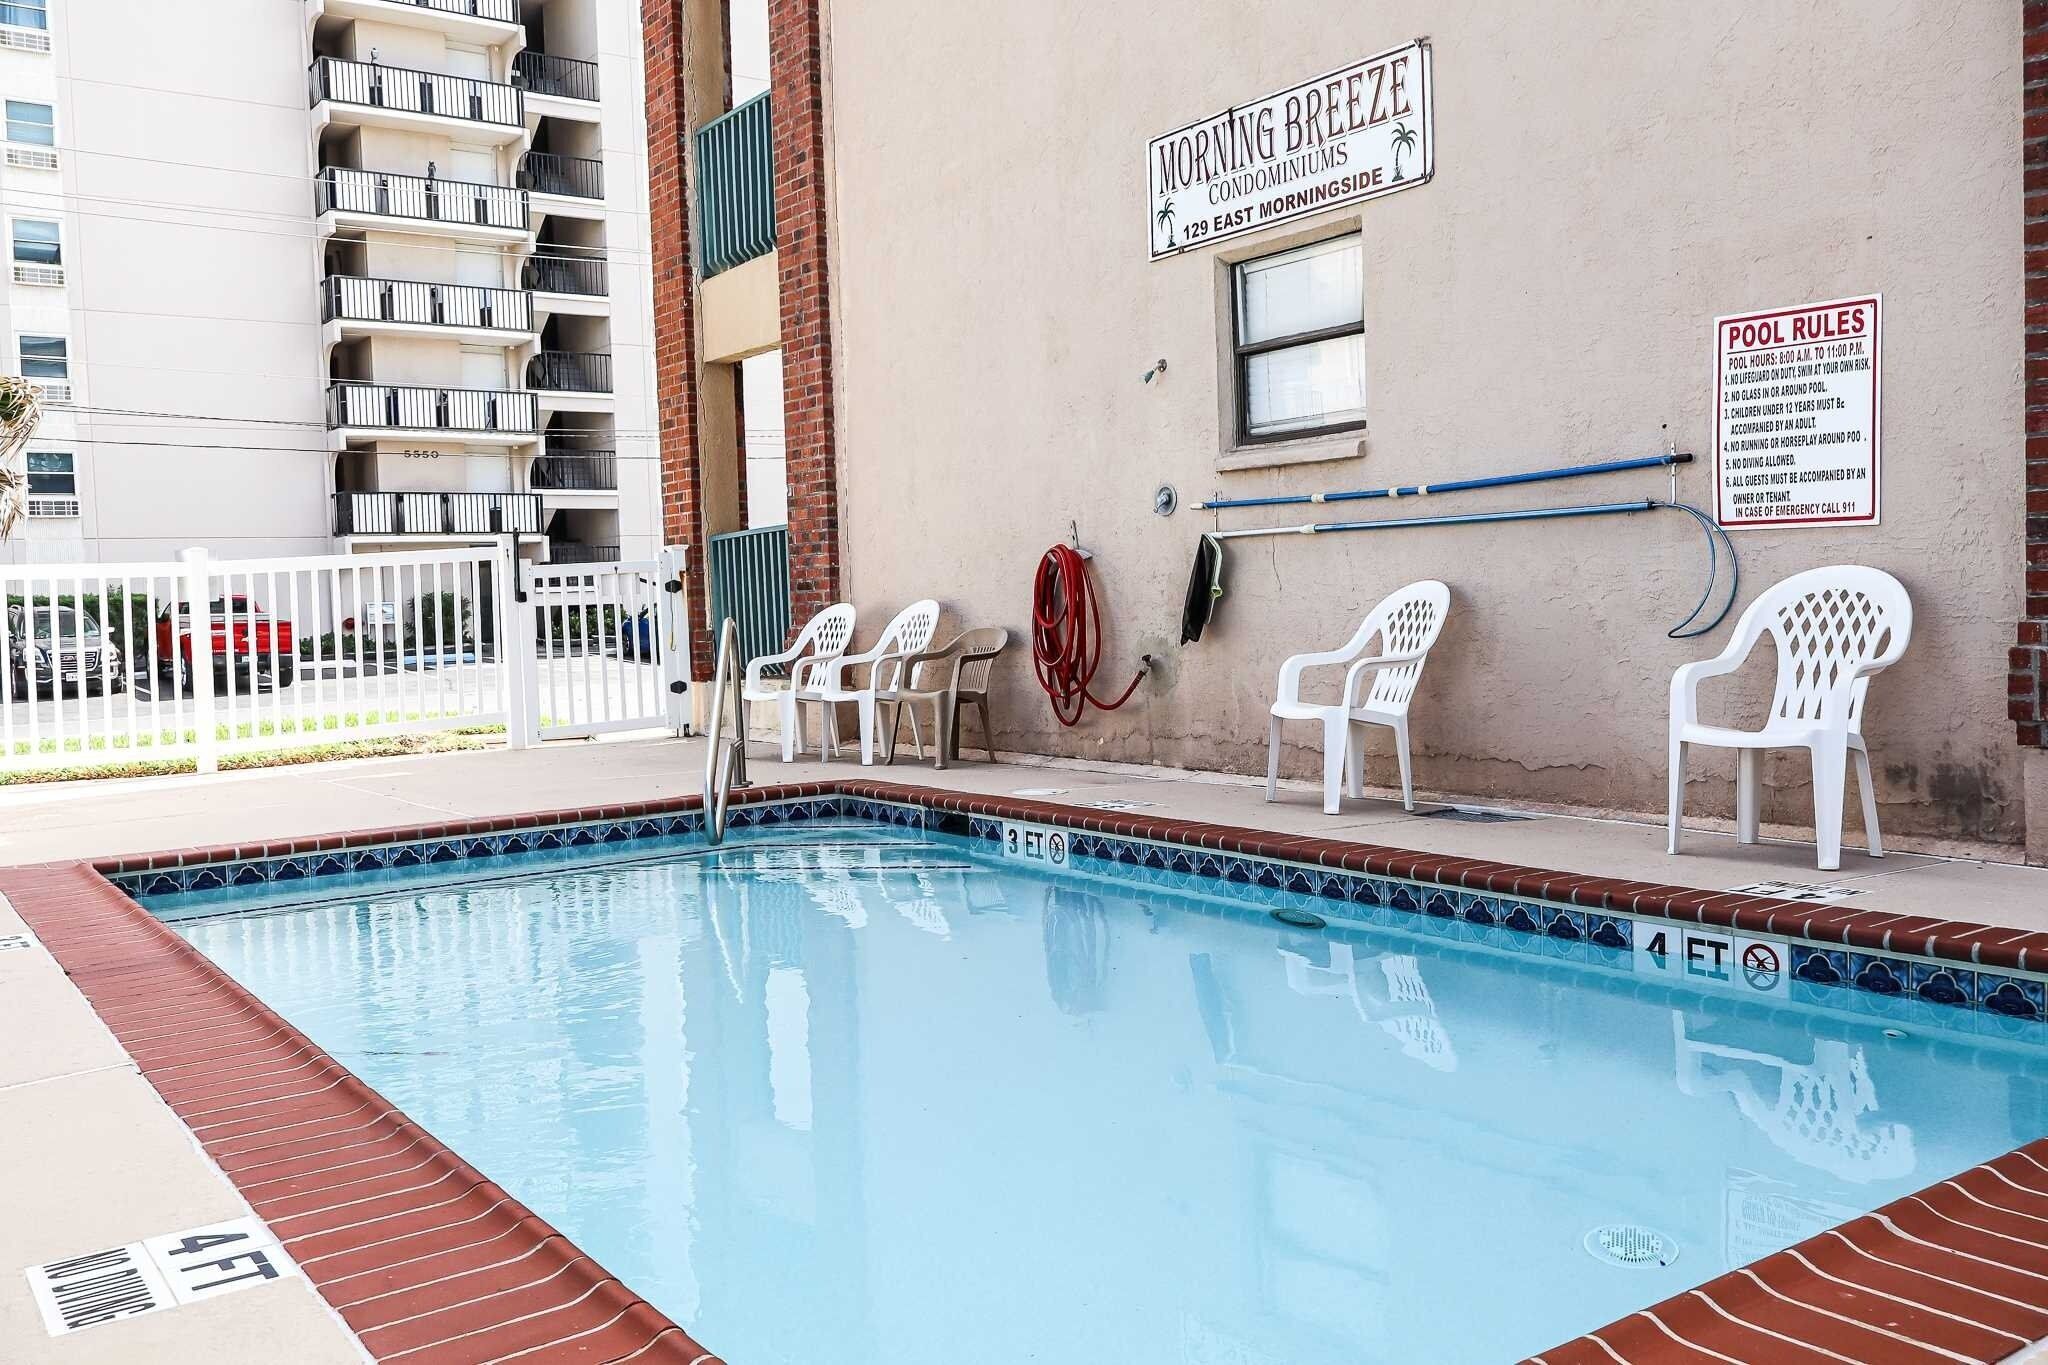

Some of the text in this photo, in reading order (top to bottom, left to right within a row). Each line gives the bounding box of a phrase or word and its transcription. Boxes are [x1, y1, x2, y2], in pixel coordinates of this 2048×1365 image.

[1158, 56, 1413, 197] MORNING BREEZE
[1209, 142, 1348, 205] CONDOMINIUMS
[1183, 167, 1383, 240] 129 EAST MORNINGSIDE
[1729, 308, 1865, 349] POOL RULES
[1729, 342, 1864, 370] POOL HOURS: 8:00 A.M. TO 11:00 P.M.
[1725, 358, 1870, 386] 1. NO LIFEGUARD ON DUTY, SWIM AT YOUR OWN RISK.
[1725, 381, 1827, 402] 2. NO GLASS IN OR AROUND POOL.
[1725, 409, 1729, 420] 3.
[1731, 405, 1761, 419] CHILDREN
[1763, 403, 1783, 416] UNDER
[1786, 402, 1793, 413] 12
[1795, 399, 1814, 412] YEARS
[1817, 397, 1834, 410] MUST
[1731, 417, 1816, 435] ACCOMPANIED BY AN ADULT.
[1724, 441, 1729, 452] 4.
[1731, 441, 1739, 452] NO
[1741, 438, 1768, 450] RUNNING
[1771, 437, 1779, 448] OR
[1781, 434, 1817, 447] HORSEPLAY
[1819, 432, 1845, 445] AROUND
[1725, 454, 1796, 470] 5. NO DIVING ALLOWED.
[1726, 467, 1866, 488] 6. ALL GUESTS MUST BE ACCOMPANIED BY AN
[1733, 491, 1791, 504] OWNER OR TENANT.
[1736, 502, 1855, 517] IN CASE OF EMERGENCY CALL 911
[168, 1233, 280, 1291] 4 FT
[43, 1248, 156, 1329] NO DIVING
